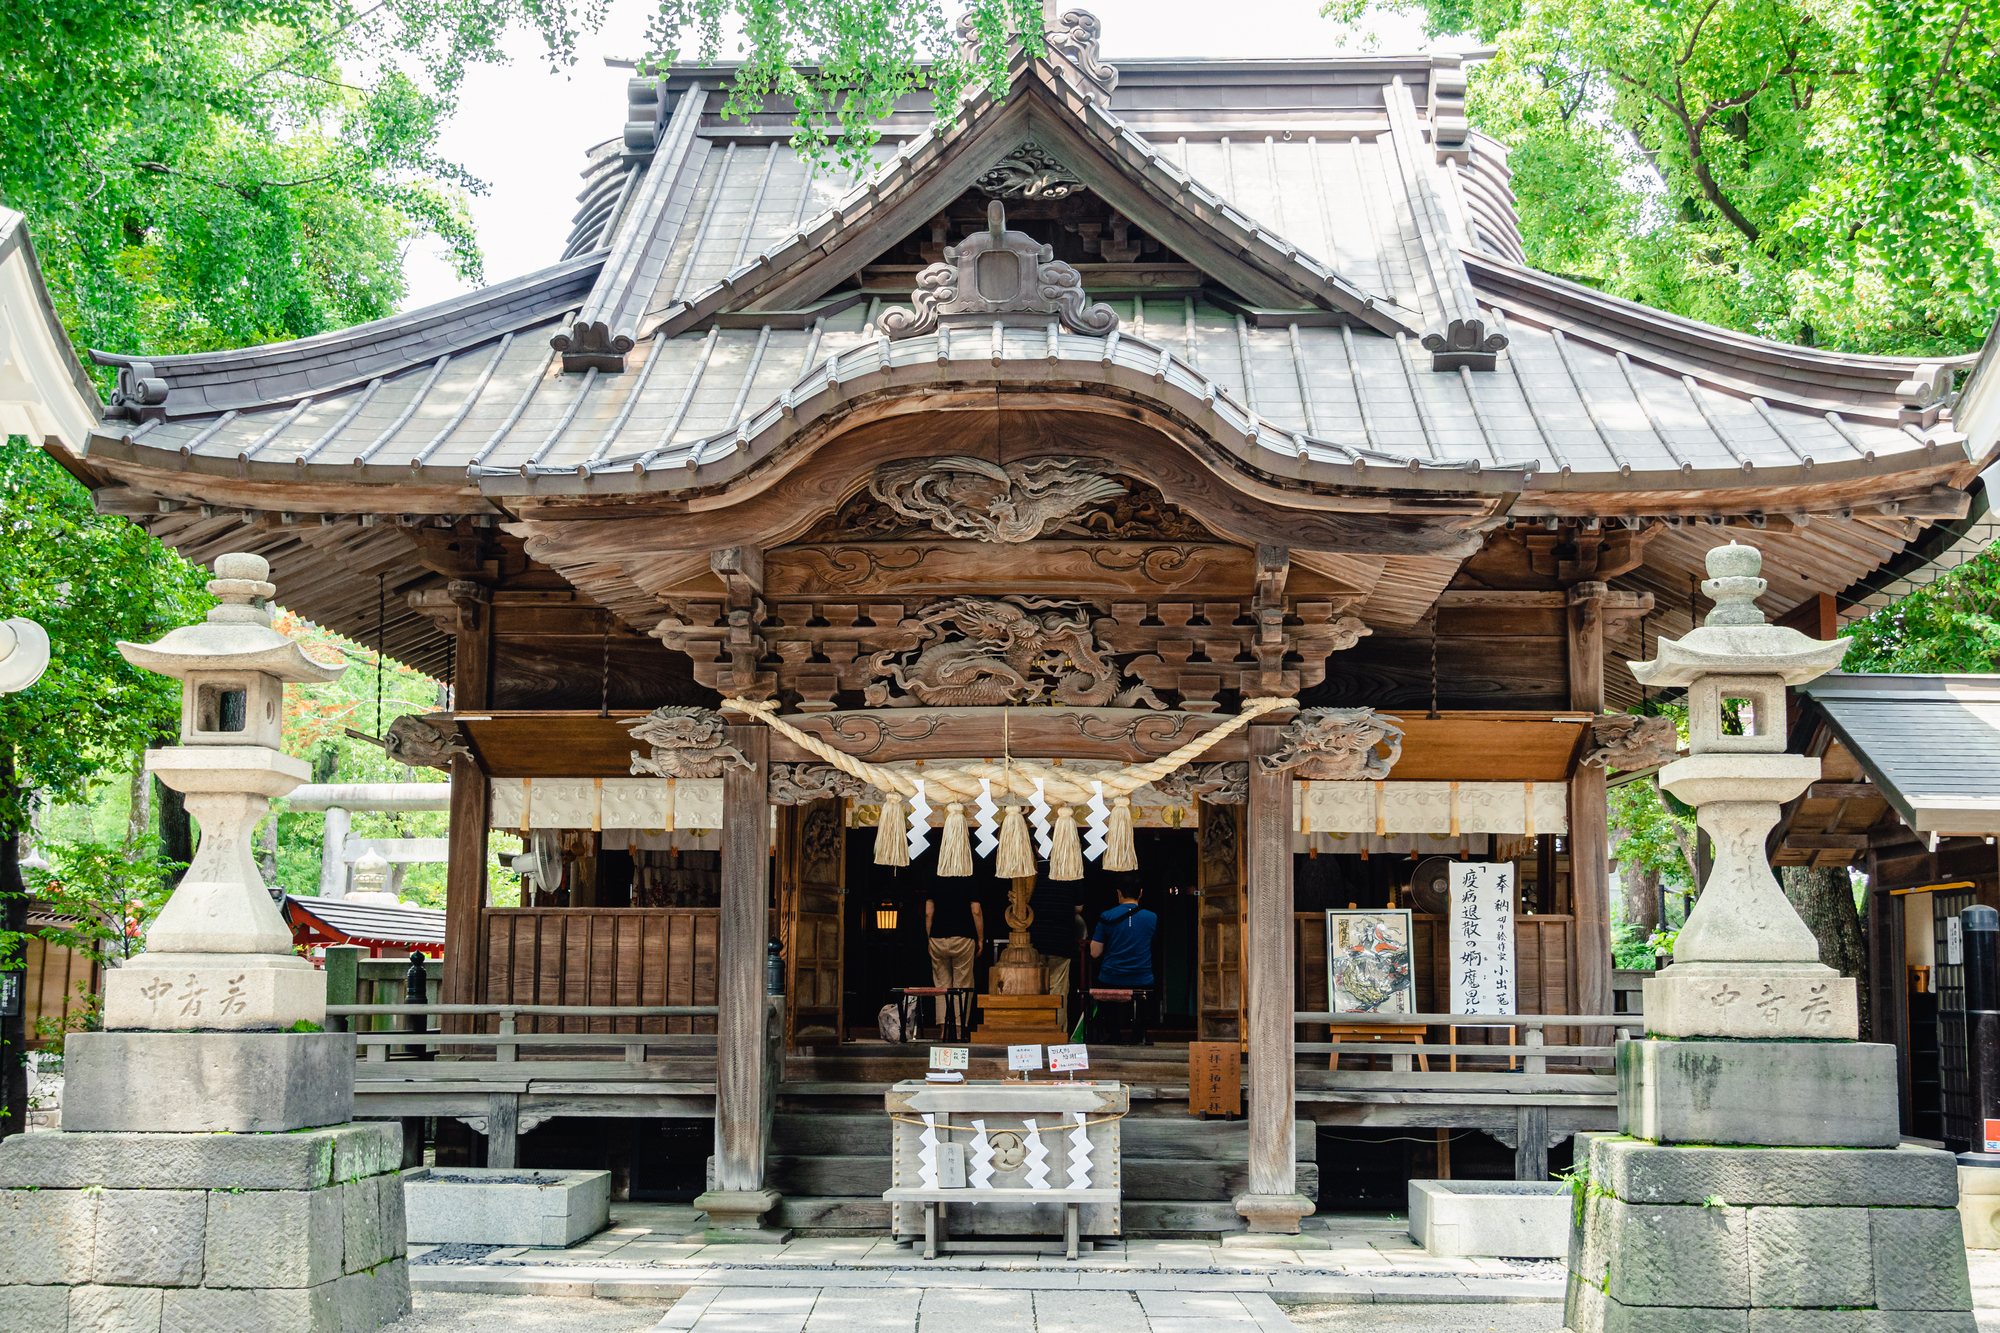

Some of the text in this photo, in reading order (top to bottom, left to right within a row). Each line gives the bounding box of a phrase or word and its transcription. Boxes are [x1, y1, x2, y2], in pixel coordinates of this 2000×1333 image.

[1208, 1045, 1222, 1112] 二拝二拍手一拝
